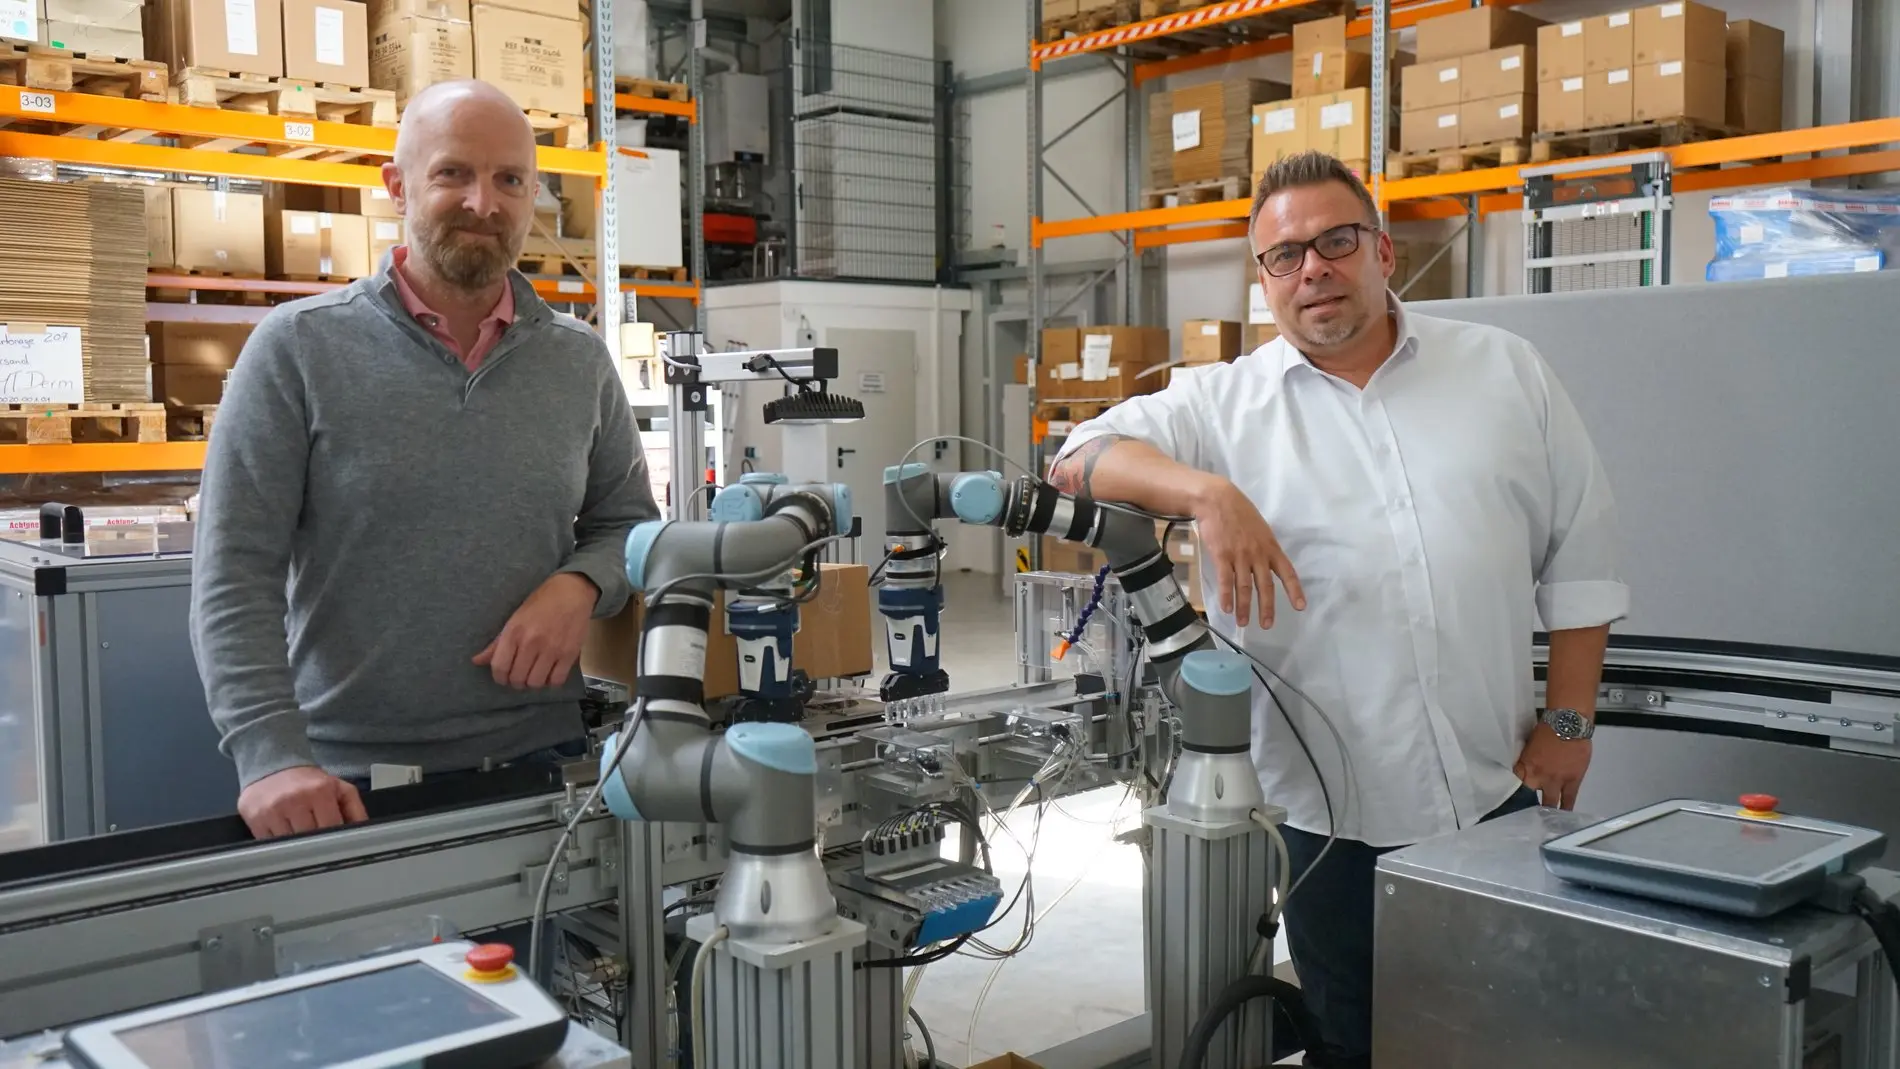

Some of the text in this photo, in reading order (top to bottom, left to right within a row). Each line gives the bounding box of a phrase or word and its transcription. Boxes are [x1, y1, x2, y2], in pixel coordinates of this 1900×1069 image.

[22, 94, 52, 108] 3-03
[286, 124, 311, 137] 3-02
[0, 333, 35, 349] rtonage
[24, 370, 74, 390] Derm
